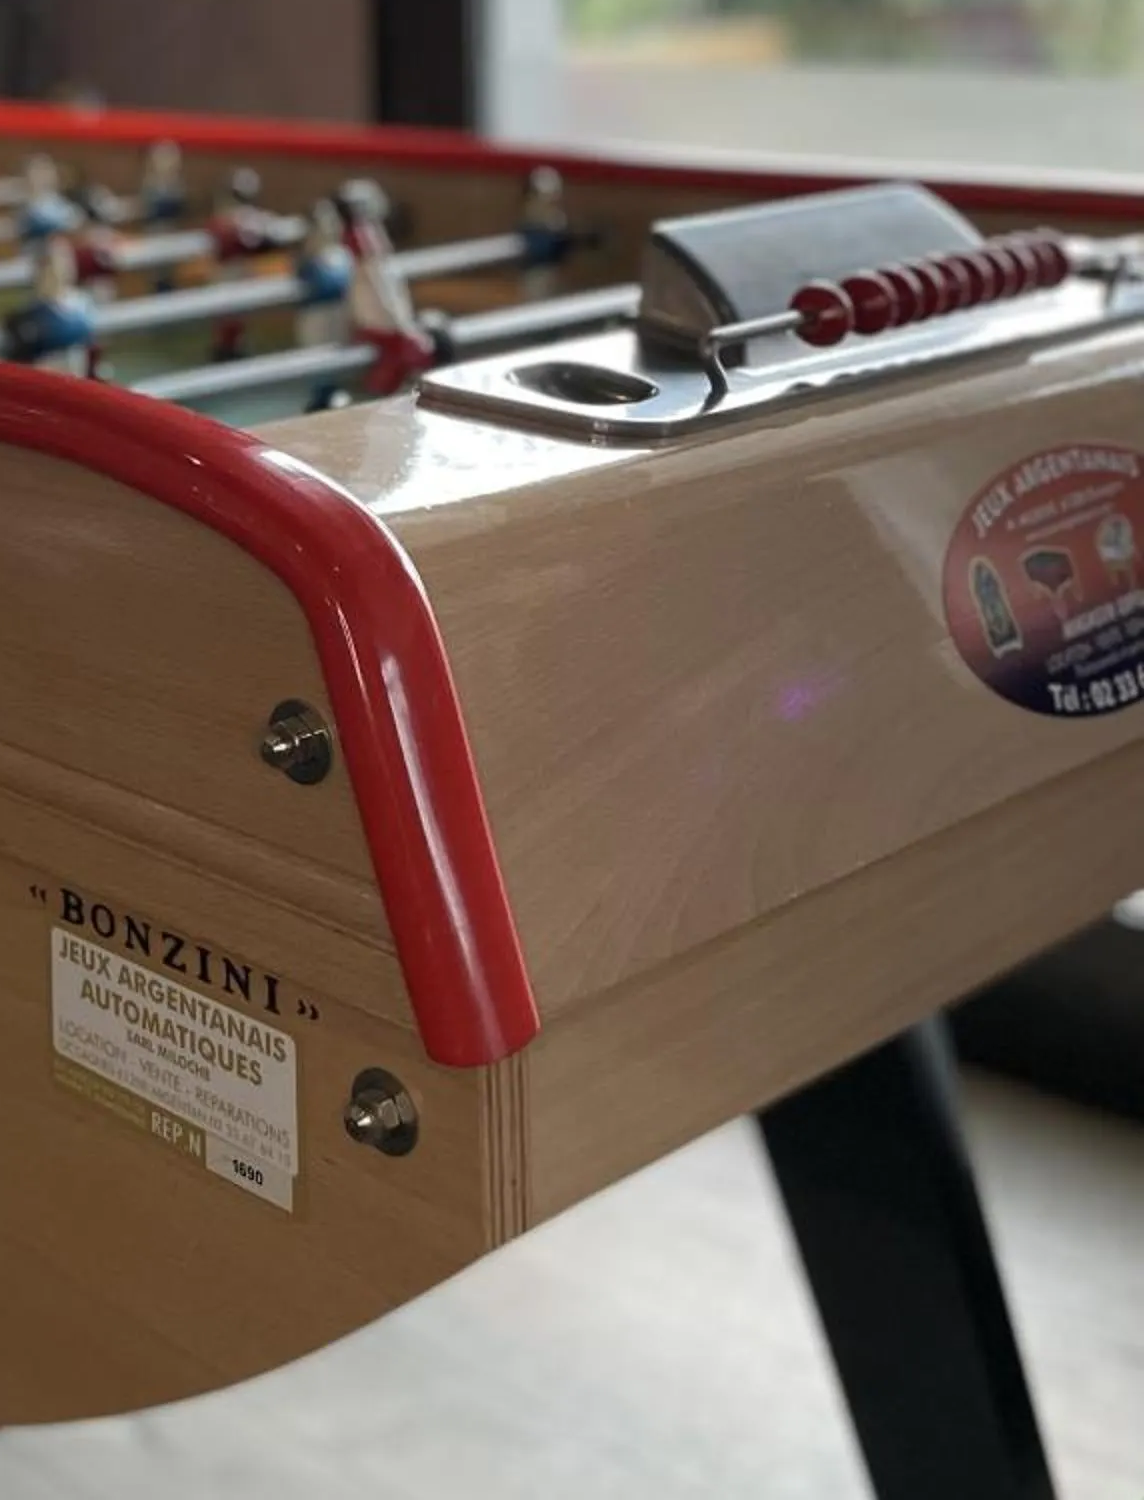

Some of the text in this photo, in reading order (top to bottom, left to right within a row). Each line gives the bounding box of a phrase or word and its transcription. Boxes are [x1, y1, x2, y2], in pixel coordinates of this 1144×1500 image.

[59, 888, 280, 1015] BONZINI
[59, 936, 286, 1063] JEUX ARGENTANAIS
[58, 1015, 127, 1062] LOCATION
[139, 1059, 181, 1093] VENTE
[195, 1086, 290, 1149] REPARATIONS
[81, 979, 262, 1086] AUTOMATIQUES
[232, 1159, 264, 1186] 1690
